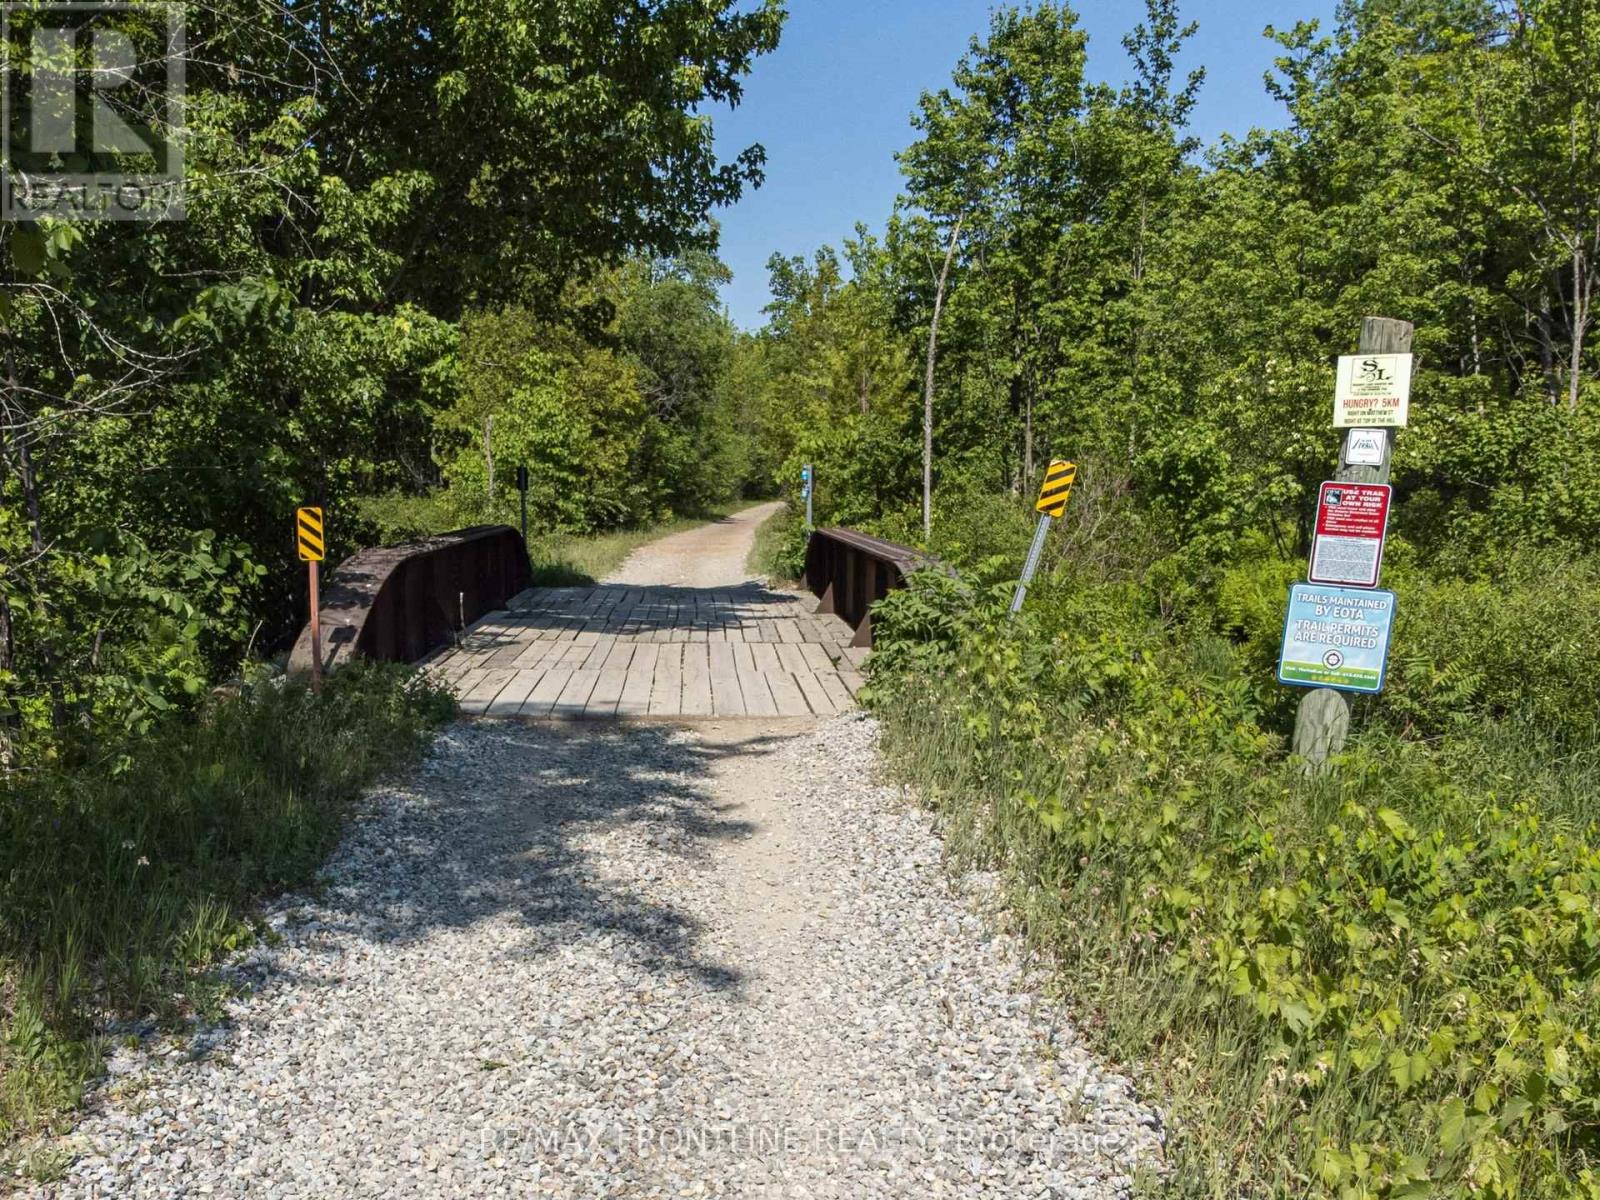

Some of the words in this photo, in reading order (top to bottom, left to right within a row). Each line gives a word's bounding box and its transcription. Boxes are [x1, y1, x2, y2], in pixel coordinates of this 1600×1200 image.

[1343, 399, 1378, 408] HUNGRY?
[1382, 398, 1400, 407] 5KM
[1297, 593, 1328, 604] TRAILS
[1329, 596, 1387, 609] MAINTAINED
[1315, 605, 1331, 616] BY
[1333, 608, 1365, 620] EOTA
[1295, 619, 1327, 632] TRAIL
[1329, 623, 1379, 637] PERMITS
[1294, 631, 1317, 642] ARE
[1318, 633, 1377, 649] REQUIRED
